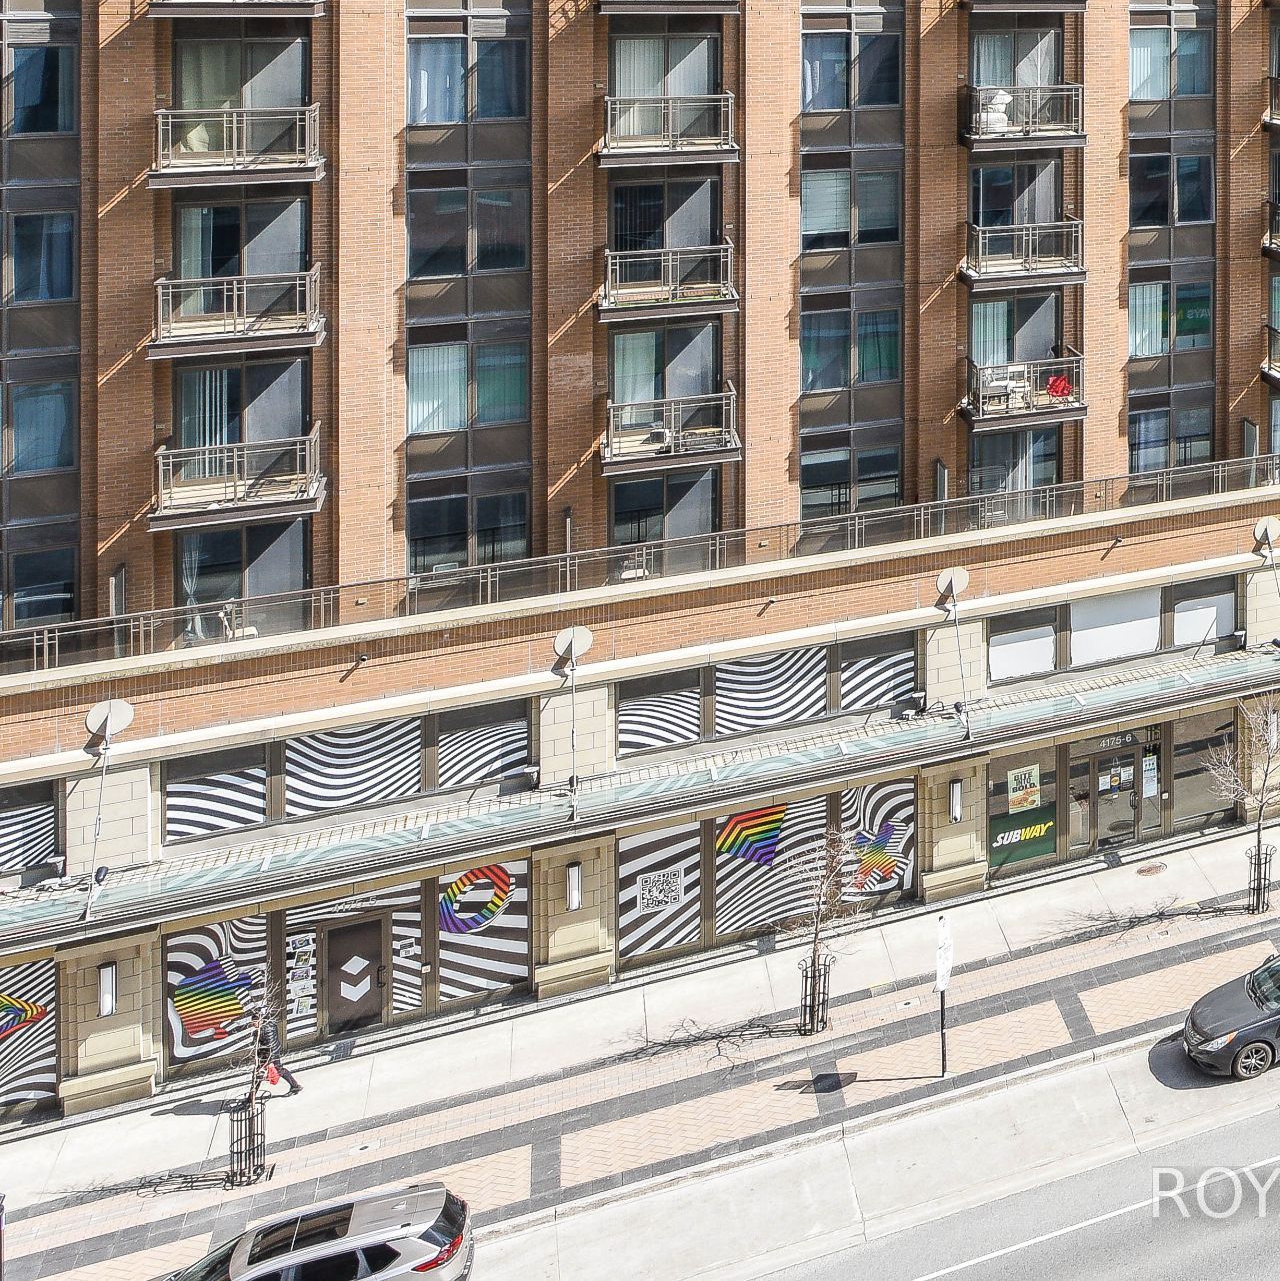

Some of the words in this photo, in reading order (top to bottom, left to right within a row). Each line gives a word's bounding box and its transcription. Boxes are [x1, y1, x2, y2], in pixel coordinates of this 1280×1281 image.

[1100, 733, 1132, 748] 4175-6
[1014, 771, 1033, 782] BITE
[1016, 777, 1032, 787] INTO
[992, 820, 1054, 848] SUBWAY
